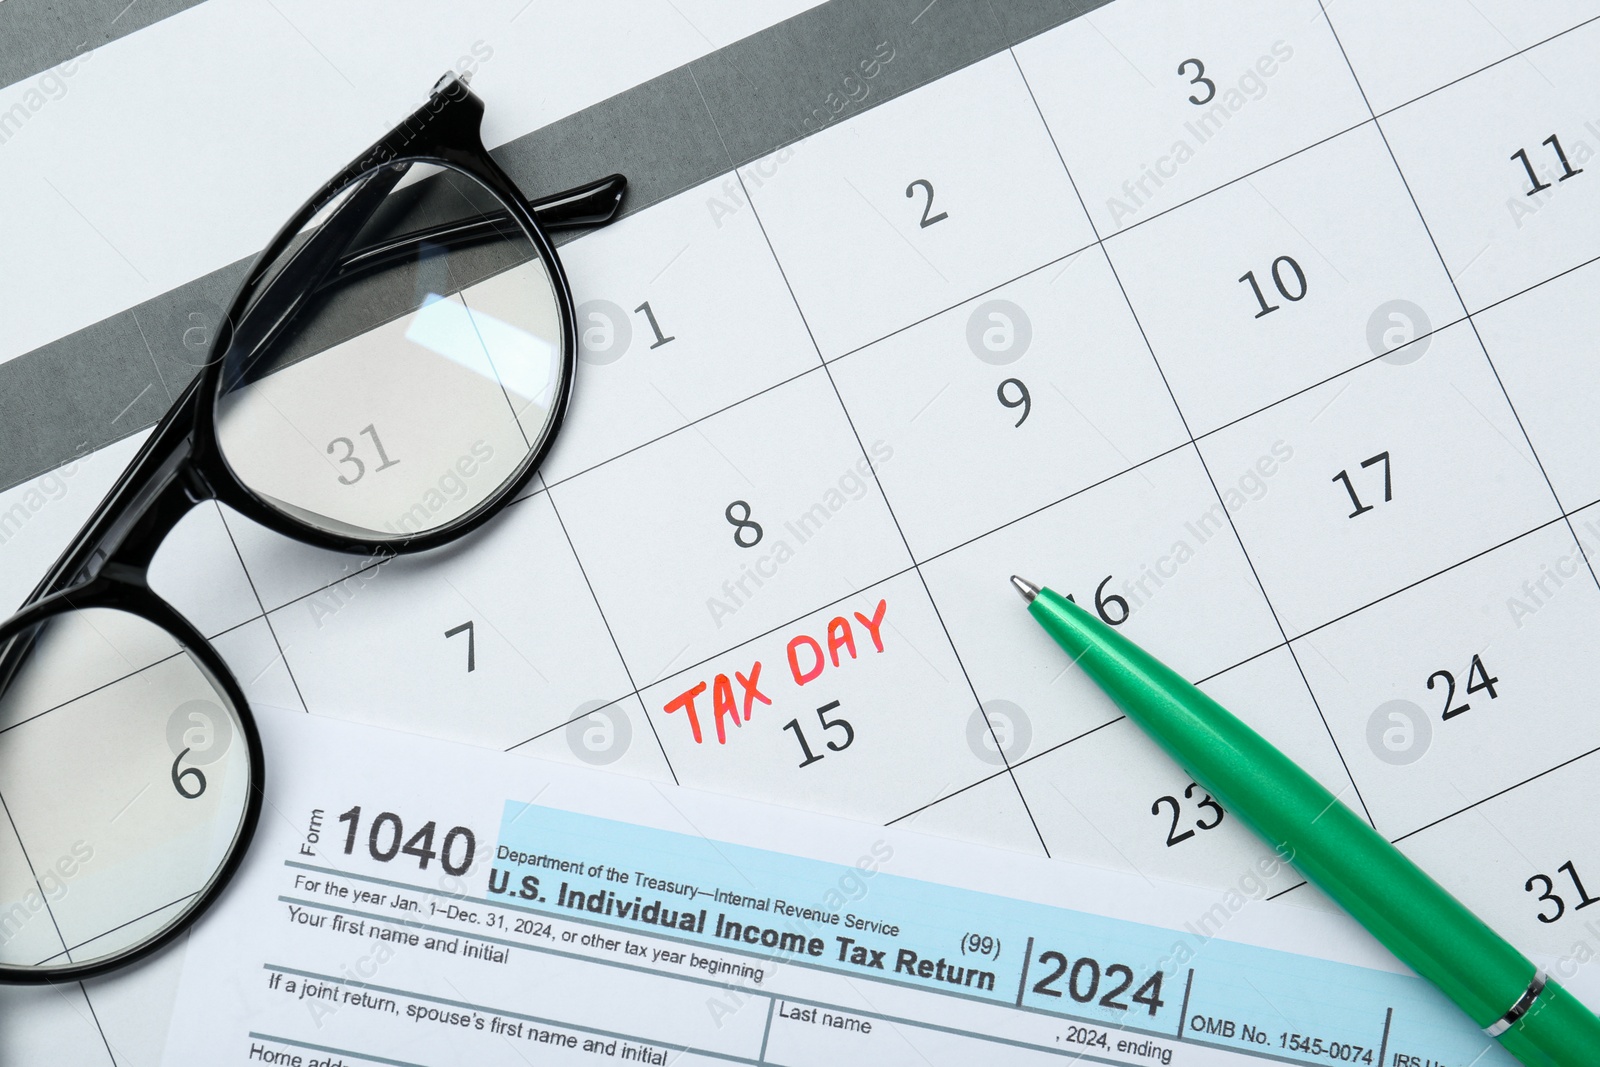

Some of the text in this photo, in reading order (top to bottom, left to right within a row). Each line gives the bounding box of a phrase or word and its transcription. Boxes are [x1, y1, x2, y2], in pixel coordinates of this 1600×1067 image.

[1177, 58, 1216, 106] 3
[1509, 133, 1584, 197] 11
[905, 178, 949, 229] 2
[1238, 255, 1308, 320] 10
[634, 301, 676, 351] 1
[996, 377, 1032, 429] 9
[326, 423, 401, 486] 31
[1331, 451, 1394, 520] 17
[725, 500, 764, 548] 8
[444, 620, 476, 673] 7
[663, 598, 888, 745] TAX DAY
[1426, 653, 1500, 722] 24
[783, 699, 855, 769] 15
[171, 747, 207, 799] 6
[299, 805, 477, 877] Form 1040
[1151, 782, 1226, 848] 23
[496, 845, 584, 875] Department
[587, 864, 603, 879] of
[606, 868, 630, 884] the
[773, 900, 841, 926] Revenue
[844, 914, 900, 937] Service
[1525, 860, 1600, 924] 31
[288, 905, 510, 964] Your first name and initial
[294, 875, 321, 892] For
[324, 880, 349, 898] the
[353, 889, 388, 905] year
[390, 895, 422, 914] Jan.
[486, 912, 509, 933] 31,
[514, 919, 556, 941] 2024,
[561, 930, 577, 943] or
[581, 933, 621, 952] other
[624, 943, 648, 958] tax
[652, 949, 687, 965] year
[689, 953, 765, 984] beginning
[487, 868, 997, 991] U.S. Individual Income Tax Return
[961, 932, 1002, 962] (99)
[1032, 950, 1165, 1017] 2024
[268, 973, 283, 990] If
[285, 979, 297, 993] a
[298, 981, 339, 1001] joint
[343, 989, 401, 1016] return,
[490, 1017, 524, 1039] first
[526, 1025, 579, 1049] name
[581, 1035, 618, 1057] and
[620, 1042, 669, 1067] initial
[778, 1001, 873, 1034] Last name
[1065, 1025, 1111, 1052] 2024,
[1116, 1038, 1173, 1066] ending
[1190, 1014, 1374, 1066] OMB No. 1545-0074
[249, 1043, 302, 1067] Home
